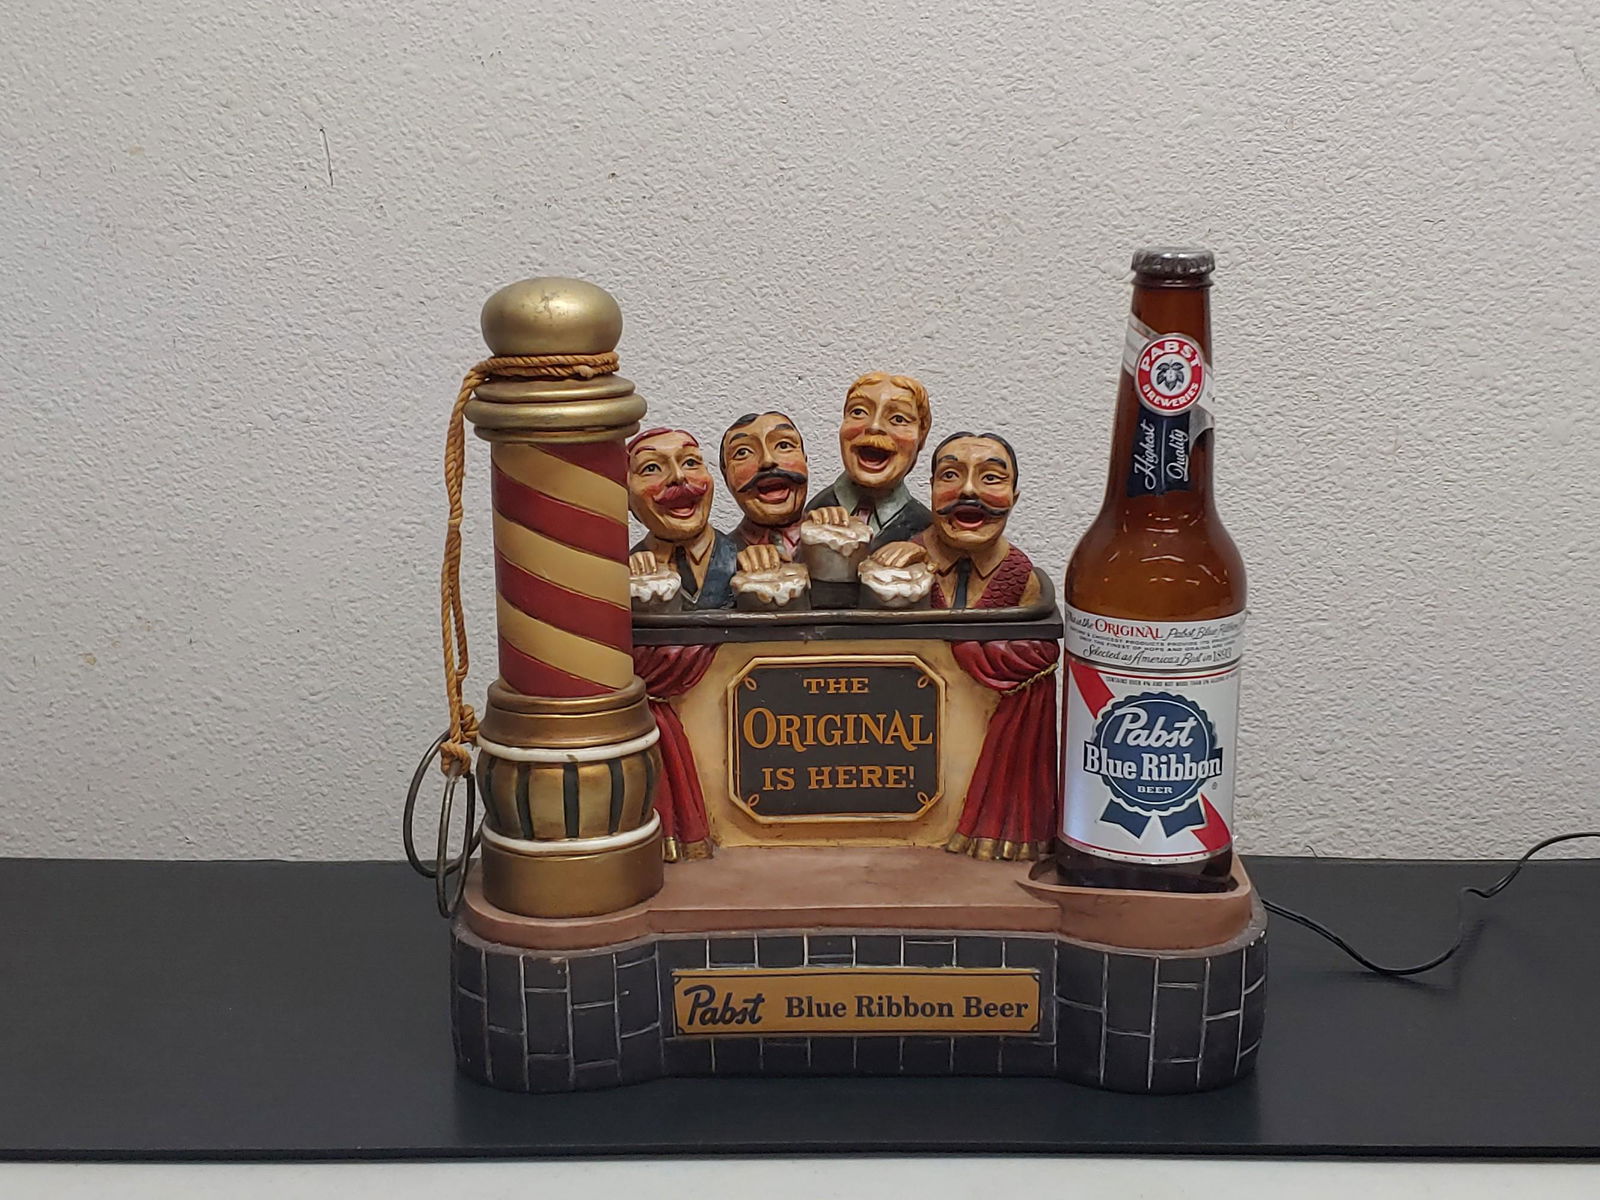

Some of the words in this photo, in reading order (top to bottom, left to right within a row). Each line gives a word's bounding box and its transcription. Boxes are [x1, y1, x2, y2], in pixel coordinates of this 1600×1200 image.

[1140, 341, 1201, 372] PABST
[1142, 383, 1199, 408] BREWERIES
[1133, 419, 1159, 490] Highest
[1166, 428, 1190, 482] Quality
[1095, 618, 1163, 640] ORIGINAL
[1162, 627, 1196, 641] Pabst
[1083, 644, 1120, 660] Selected
[803, 677, 869, 694] THE
[743, 707, 933, 752] ORIGINAL
[1114, 706, 1198, 748] Pabst
[761, 767, 795, 791] IS
[807, 765, 915, 790] HERE!
[1085, 743, 1137, 780] Blue
[1140, 753, 1222, 782] Ribbon
[1137, 785, 1173, 794] BEER
[683, 984, 765, 1027] Pabst
[785, 995, 847, 1018] Blue
[854, 995, 955, 1018] Ribbon
[962, 996, 1029, 1018] Beer
